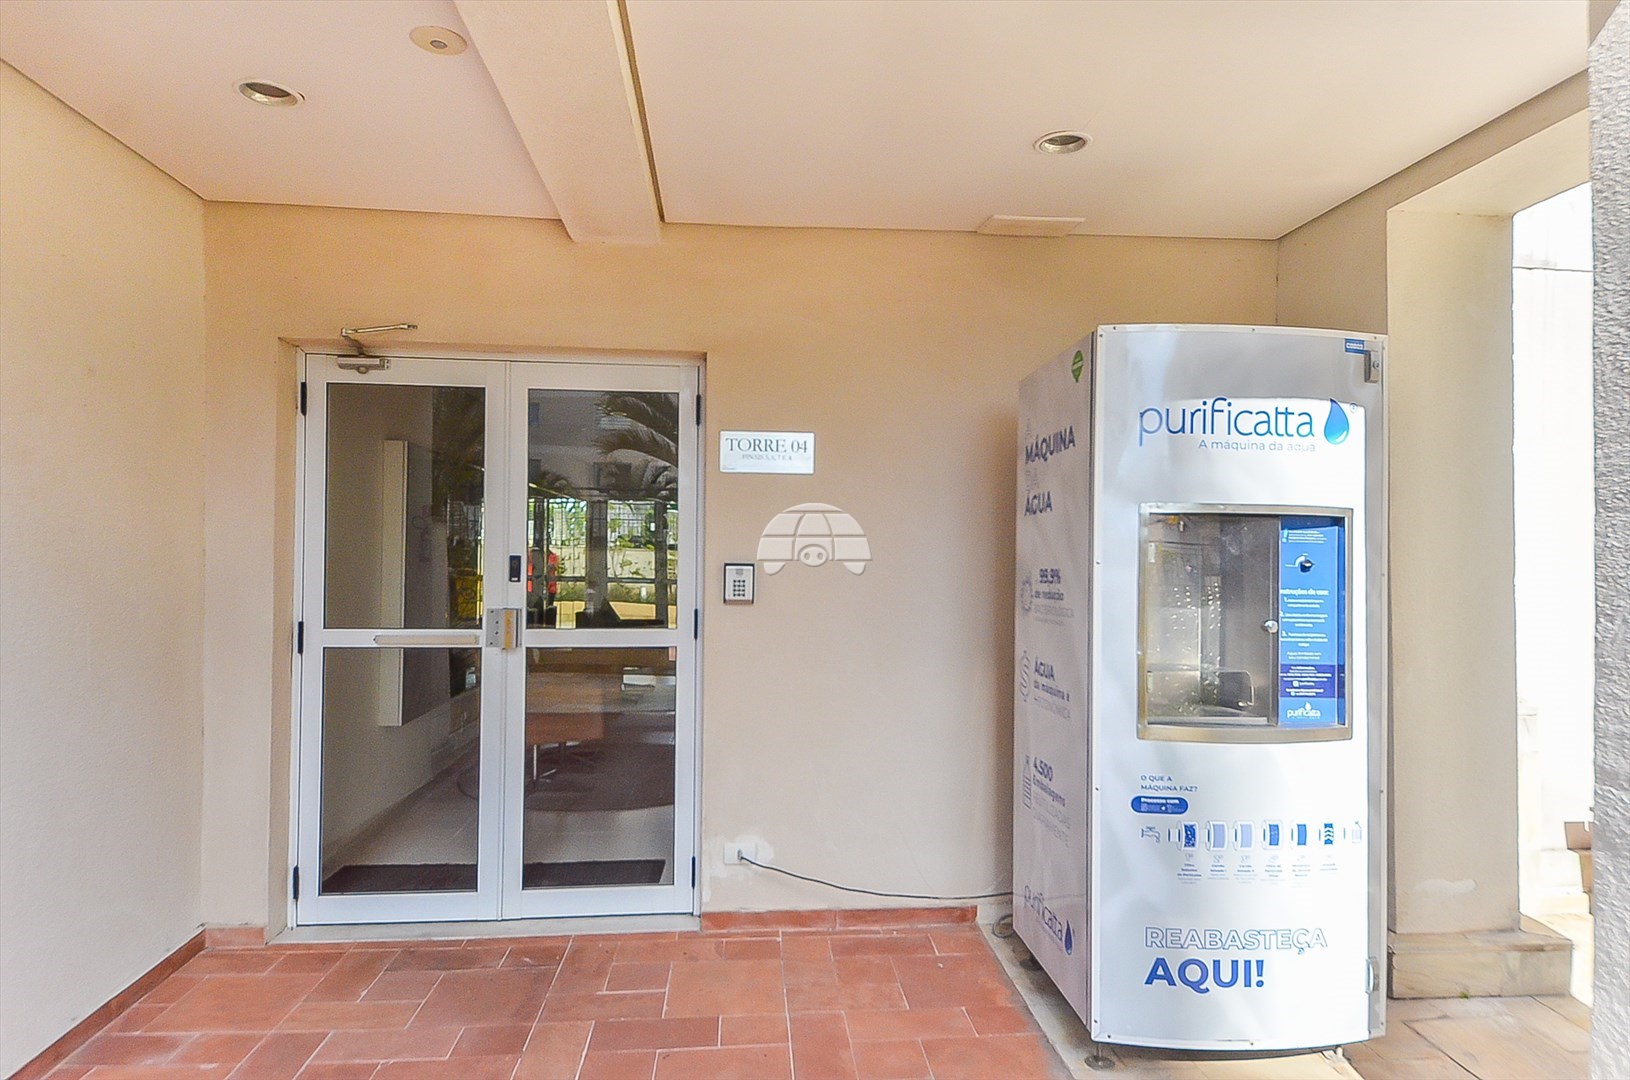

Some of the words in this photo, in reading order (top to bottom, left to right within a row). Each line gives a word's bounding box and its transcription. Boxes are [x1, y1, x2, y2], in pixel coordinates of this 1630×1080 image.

[1138, 397, 1315, 446] purificatta
[725, 437, 787, 453] TORRE
[790, 439, 808, 453] 04
[1025, 425, 1075, 464] MÁQUINA
[1198, 439, 1208, 449] A
[1211, 439, 1266, 451] máquina
[1269, 440, 1284, 451] da
[1140, 784, 1178, 792] MÁQUINA
[1149, 775, 1165, 783] QUE
[1144, 926, 1328, 955] REABASTEÇA
[1144, 957, 1265, 994] AQUI!
